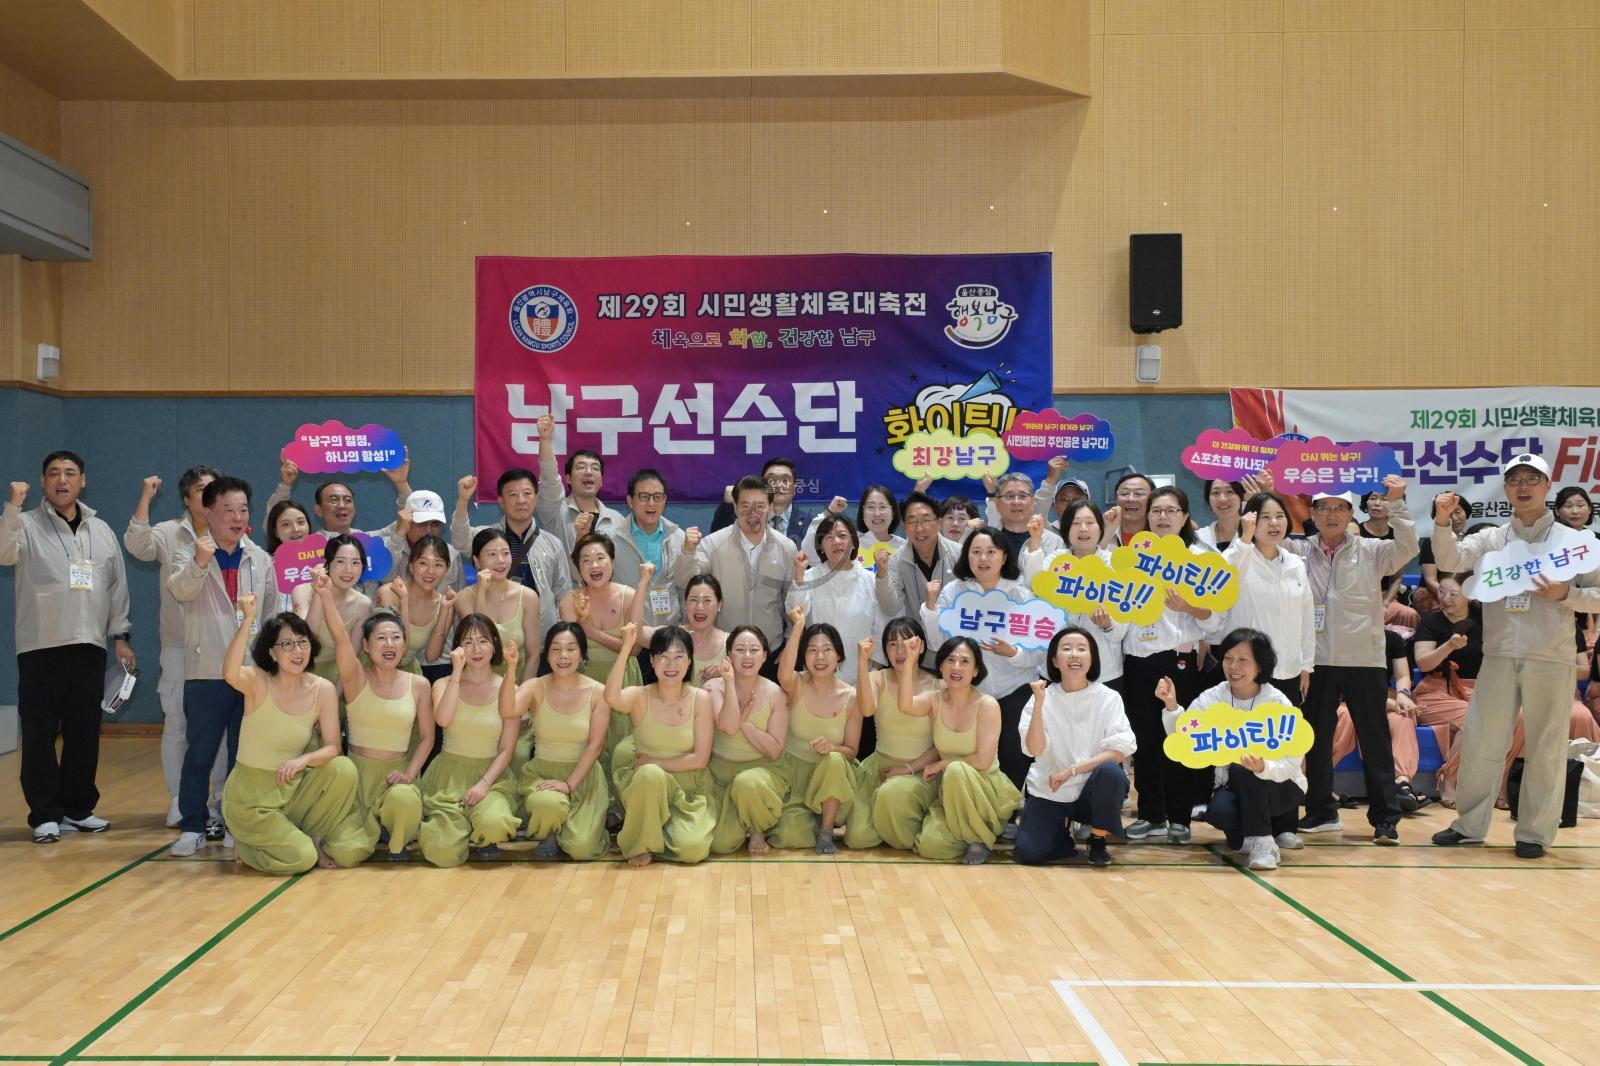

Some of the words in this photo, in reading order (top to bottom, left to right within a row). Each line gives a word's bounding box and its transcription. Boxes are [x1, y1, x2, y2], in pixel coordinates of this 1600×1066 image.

[597, 293, 685, 319] 제29회
[697, 290, 927, 319] 시민생활체육대축전
[652, 328, 723, 349] 체육으로
[728, 328, 772, 349] 화합,
[778, 328, 834, 348] 건강한
[839, 328, 877, 346] 남구
[505, 380, 864, 456] 남구선수단
[883, 402, 1030, 445] 화이팅!
[1410, 408, 1476, 429] 제29회
[1481, 405, 1600, 429] 시민생활체육
[1048, 436, 1080, 449] 주인공은
[1081, 437, 1109, 450] 남구다!
[1212, 441, 1220, 449] 더
[1251, 445, 1259, 453] 더
[325, 450, 359, 463] 하나의
[912, 446, 997, 467] 최강남구
[1190, 452, 1232, 468] 스포츠로
[1234, 457, 1268, 471] 하나되
[1300, 452, 1319, 462] 다시
[1321, 452, 1339, 462] 뛰는
[1340, 452, 1361, 462] 남구!
[1284, 467, 1334, 484] 우승은
[1338, 467, 1379, 484] 남구!
[297, 550, 315, 560] 다시
[1482, 558, 1541, 588] 건강한
[1548, 544, 1590, 568] 남구
[1134, 551, 1232, 597] 파이팅!!
[1056, 575, 1155, 613] 파이팅!!
[959, 607, 1057, 640] 남구필승
[1190, 714, 1296, 752] 파이팅!!
